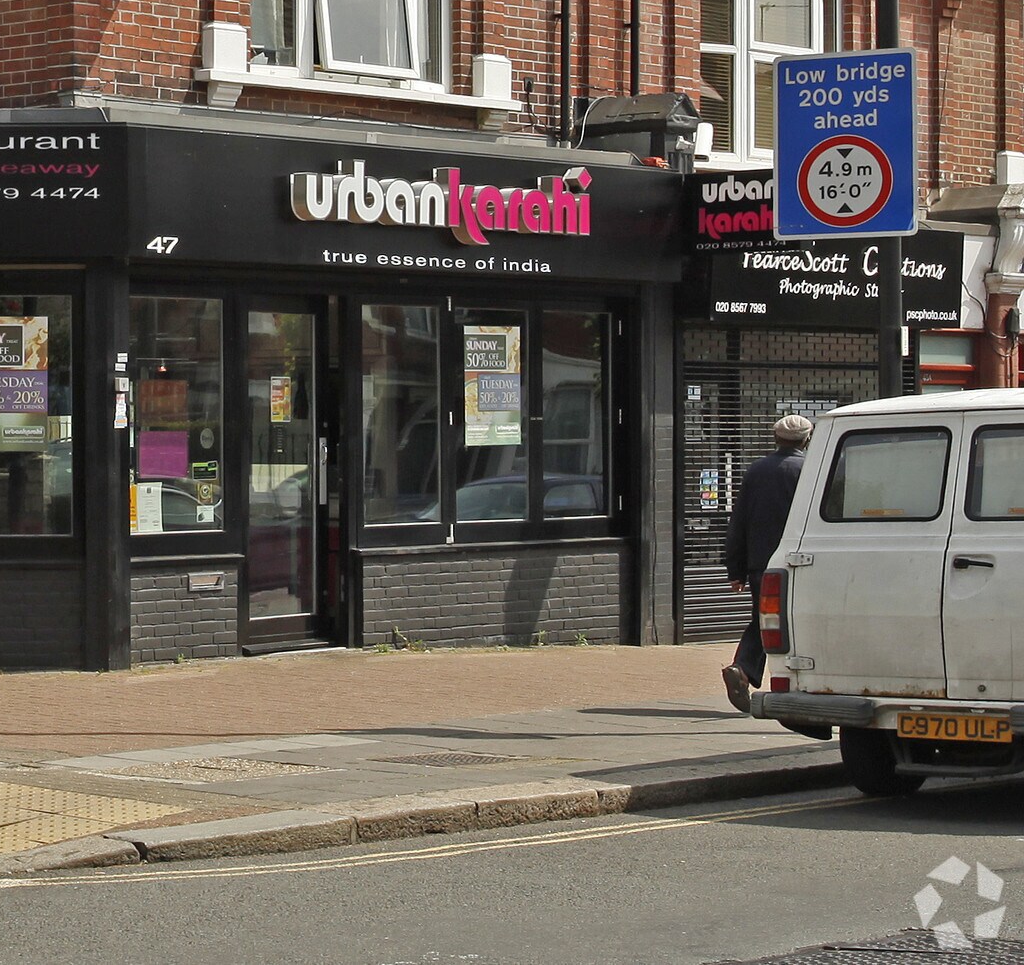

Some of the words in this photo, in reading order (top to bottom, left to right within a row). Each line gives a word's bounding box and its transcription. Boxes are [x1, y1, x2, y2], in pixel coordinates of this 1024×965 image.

[785, 67, 825, 85] Low
[836, 62, 906, 82] bridge
[799, 87, 842, 107] 200
[853, 86, 889, 107] yds
[814, 109, 878, 129] ahead
[818, 161, 852, 177] 4.9
[857, 164, 872, 176] m
[30, 187, 101, 200] 4474
[698, 204, 774, 240] karah
[146, 236, 179, 254] 47
[723, 241, 753, 249] 8579
[323, 249, 368, 264] true
[376, 254, 466, 269] essence
[475, 257, 495, 271] of
[502, 257, 552, 273] india
[779, 277, 860, 300] Photographic
[715, 301, 729, 313] 020
[730, 302, 748, 313] 8567
[749, 302, 767, 314] 7993
[906, 309, 958, 321] pscphoto.co.uk
[465, 340, 498, 351] SUNDAY
[466, 353, 488, 367] 50%
[480, 379, 514, 389] TUESDAY
[13, 391, 44, 404] 20%
[479, 392, 497, 404] 50%
[501, 392, 519, 404] 20%
[900, 716, 958, 737] C970
[964, 719, 1010, 739] ULP
